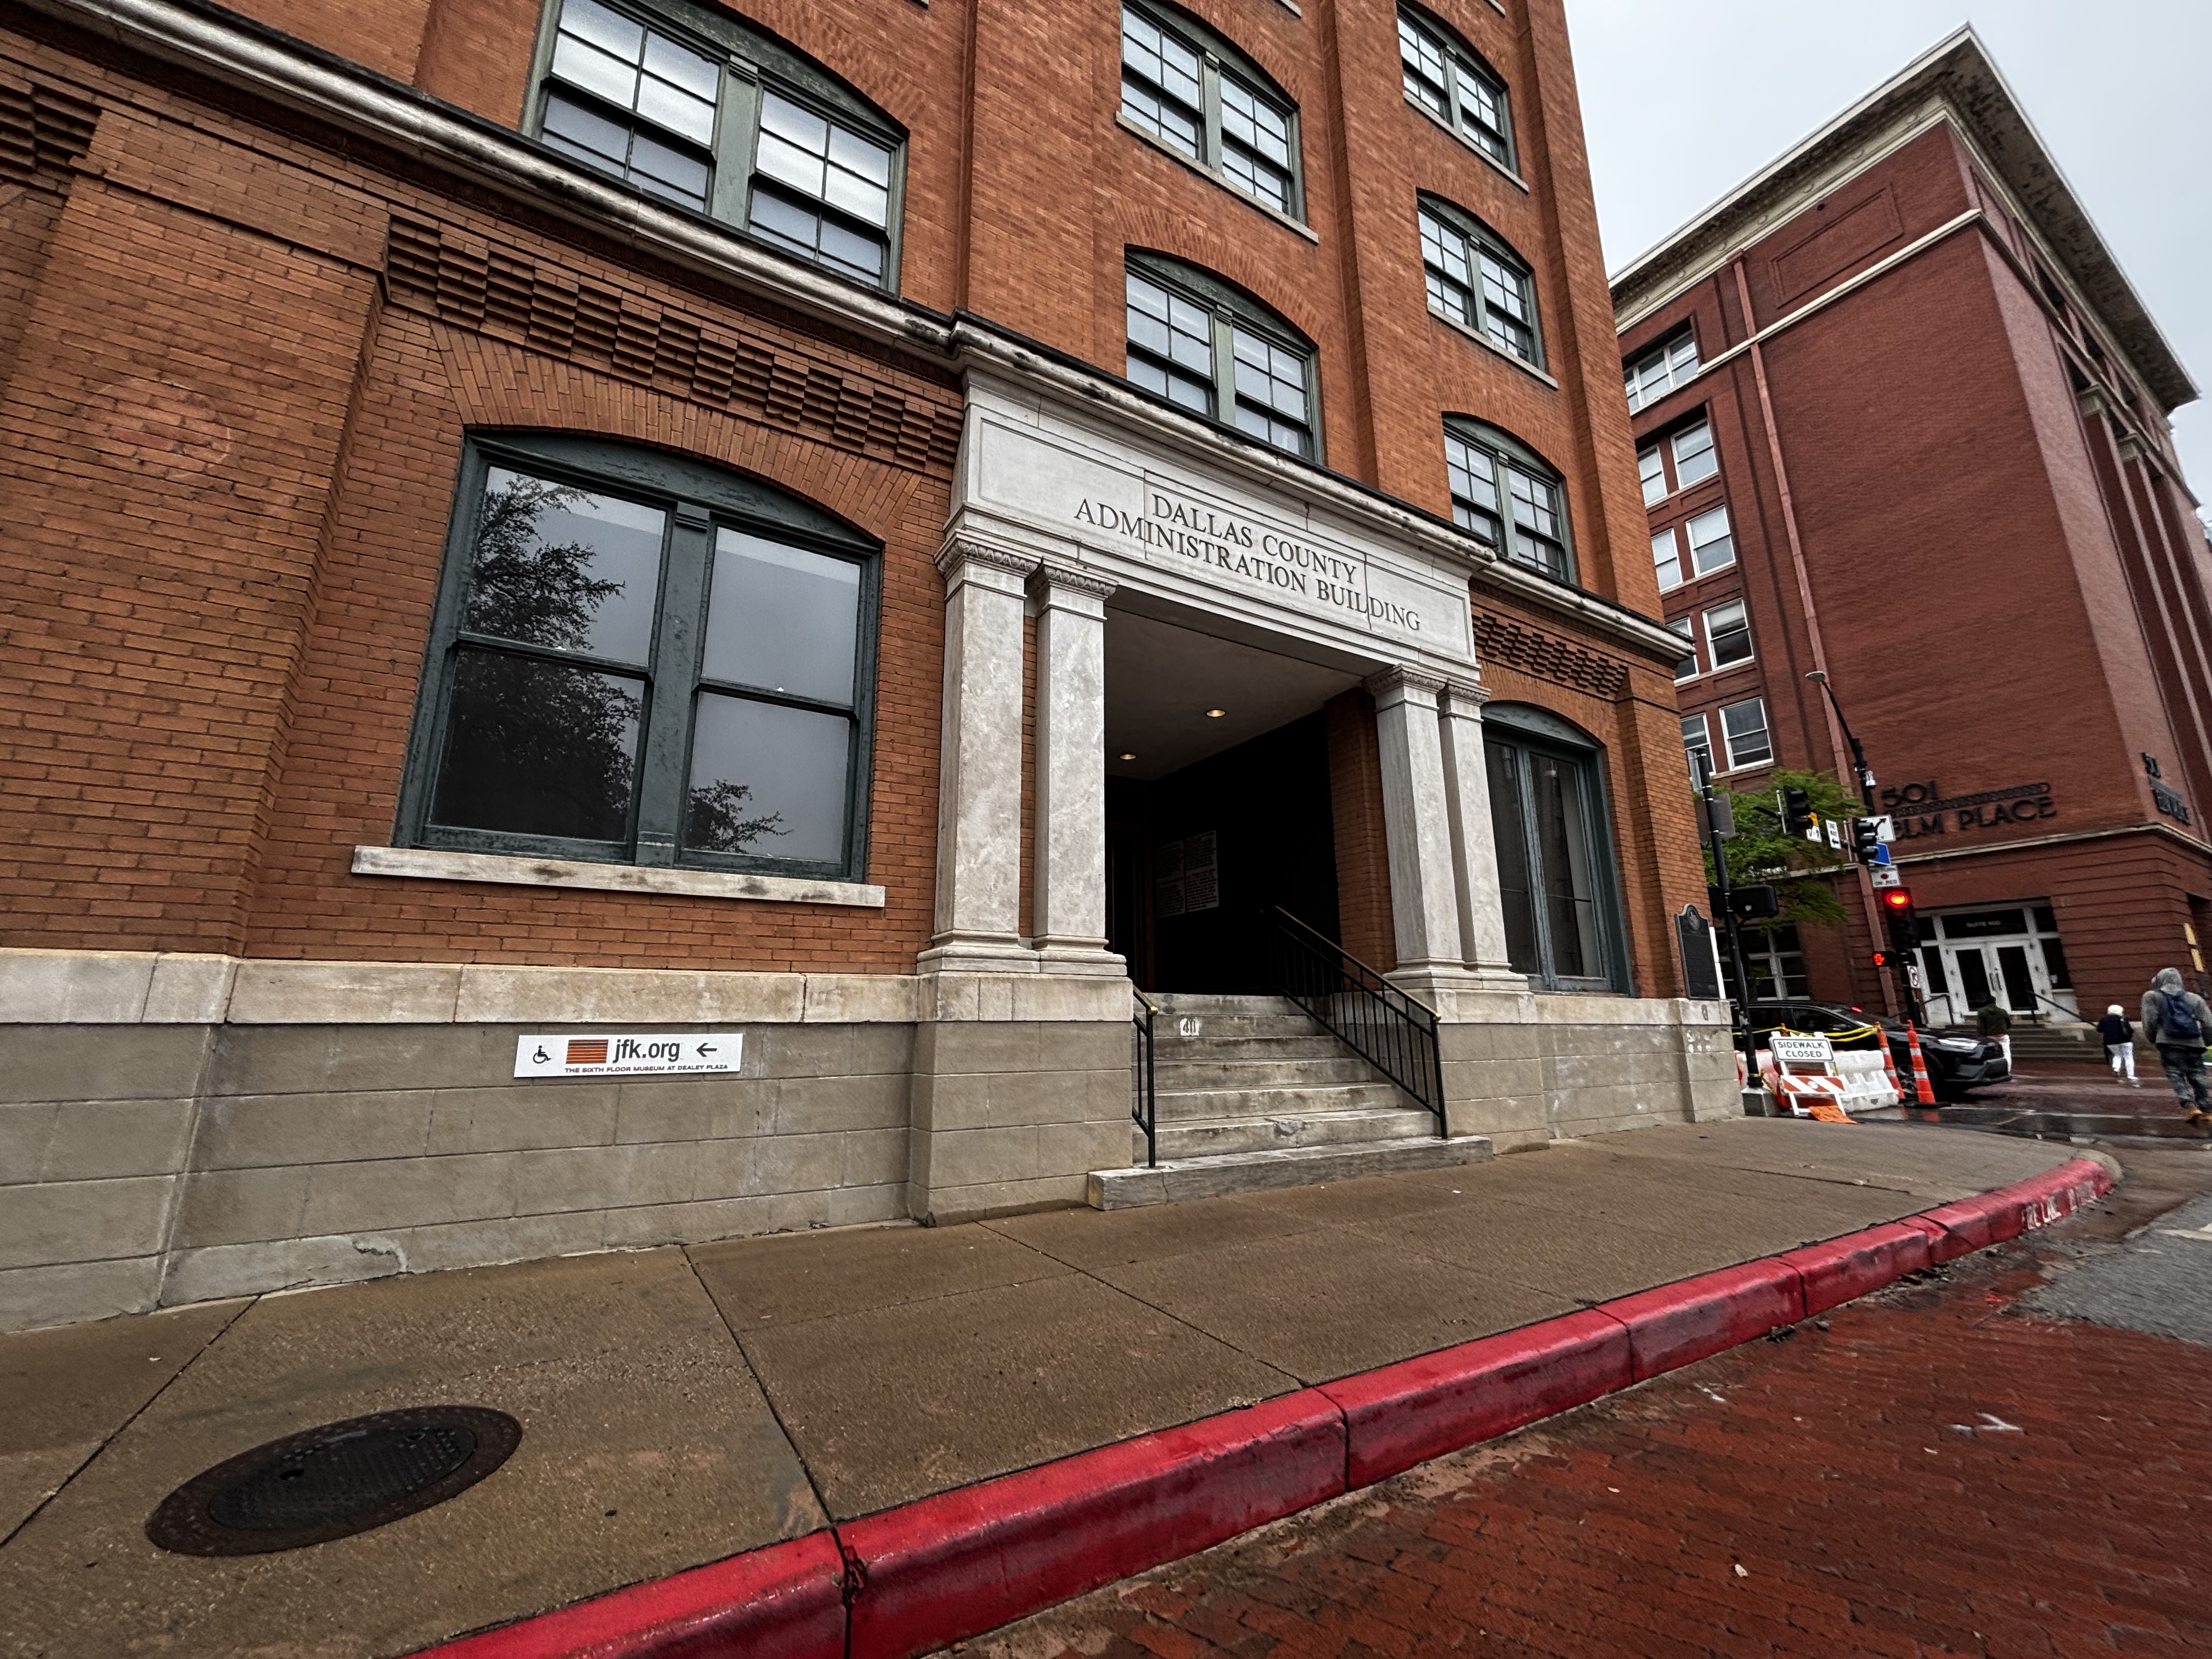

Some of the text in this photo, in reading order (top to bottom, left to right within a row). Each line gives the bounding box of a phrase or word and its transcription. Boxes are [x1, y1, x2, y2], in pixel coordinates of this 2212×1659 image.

[1152, 494, 1357, 585] DALLAS COUNTY
[1074, 498, 1421, 631] ADMINISTRATION BUILDING
[1881, 780, 1938, 808] 501
[1957, 796, 2057, 831] PLACE
[612, 1039, 680, 1063] jfk.org
